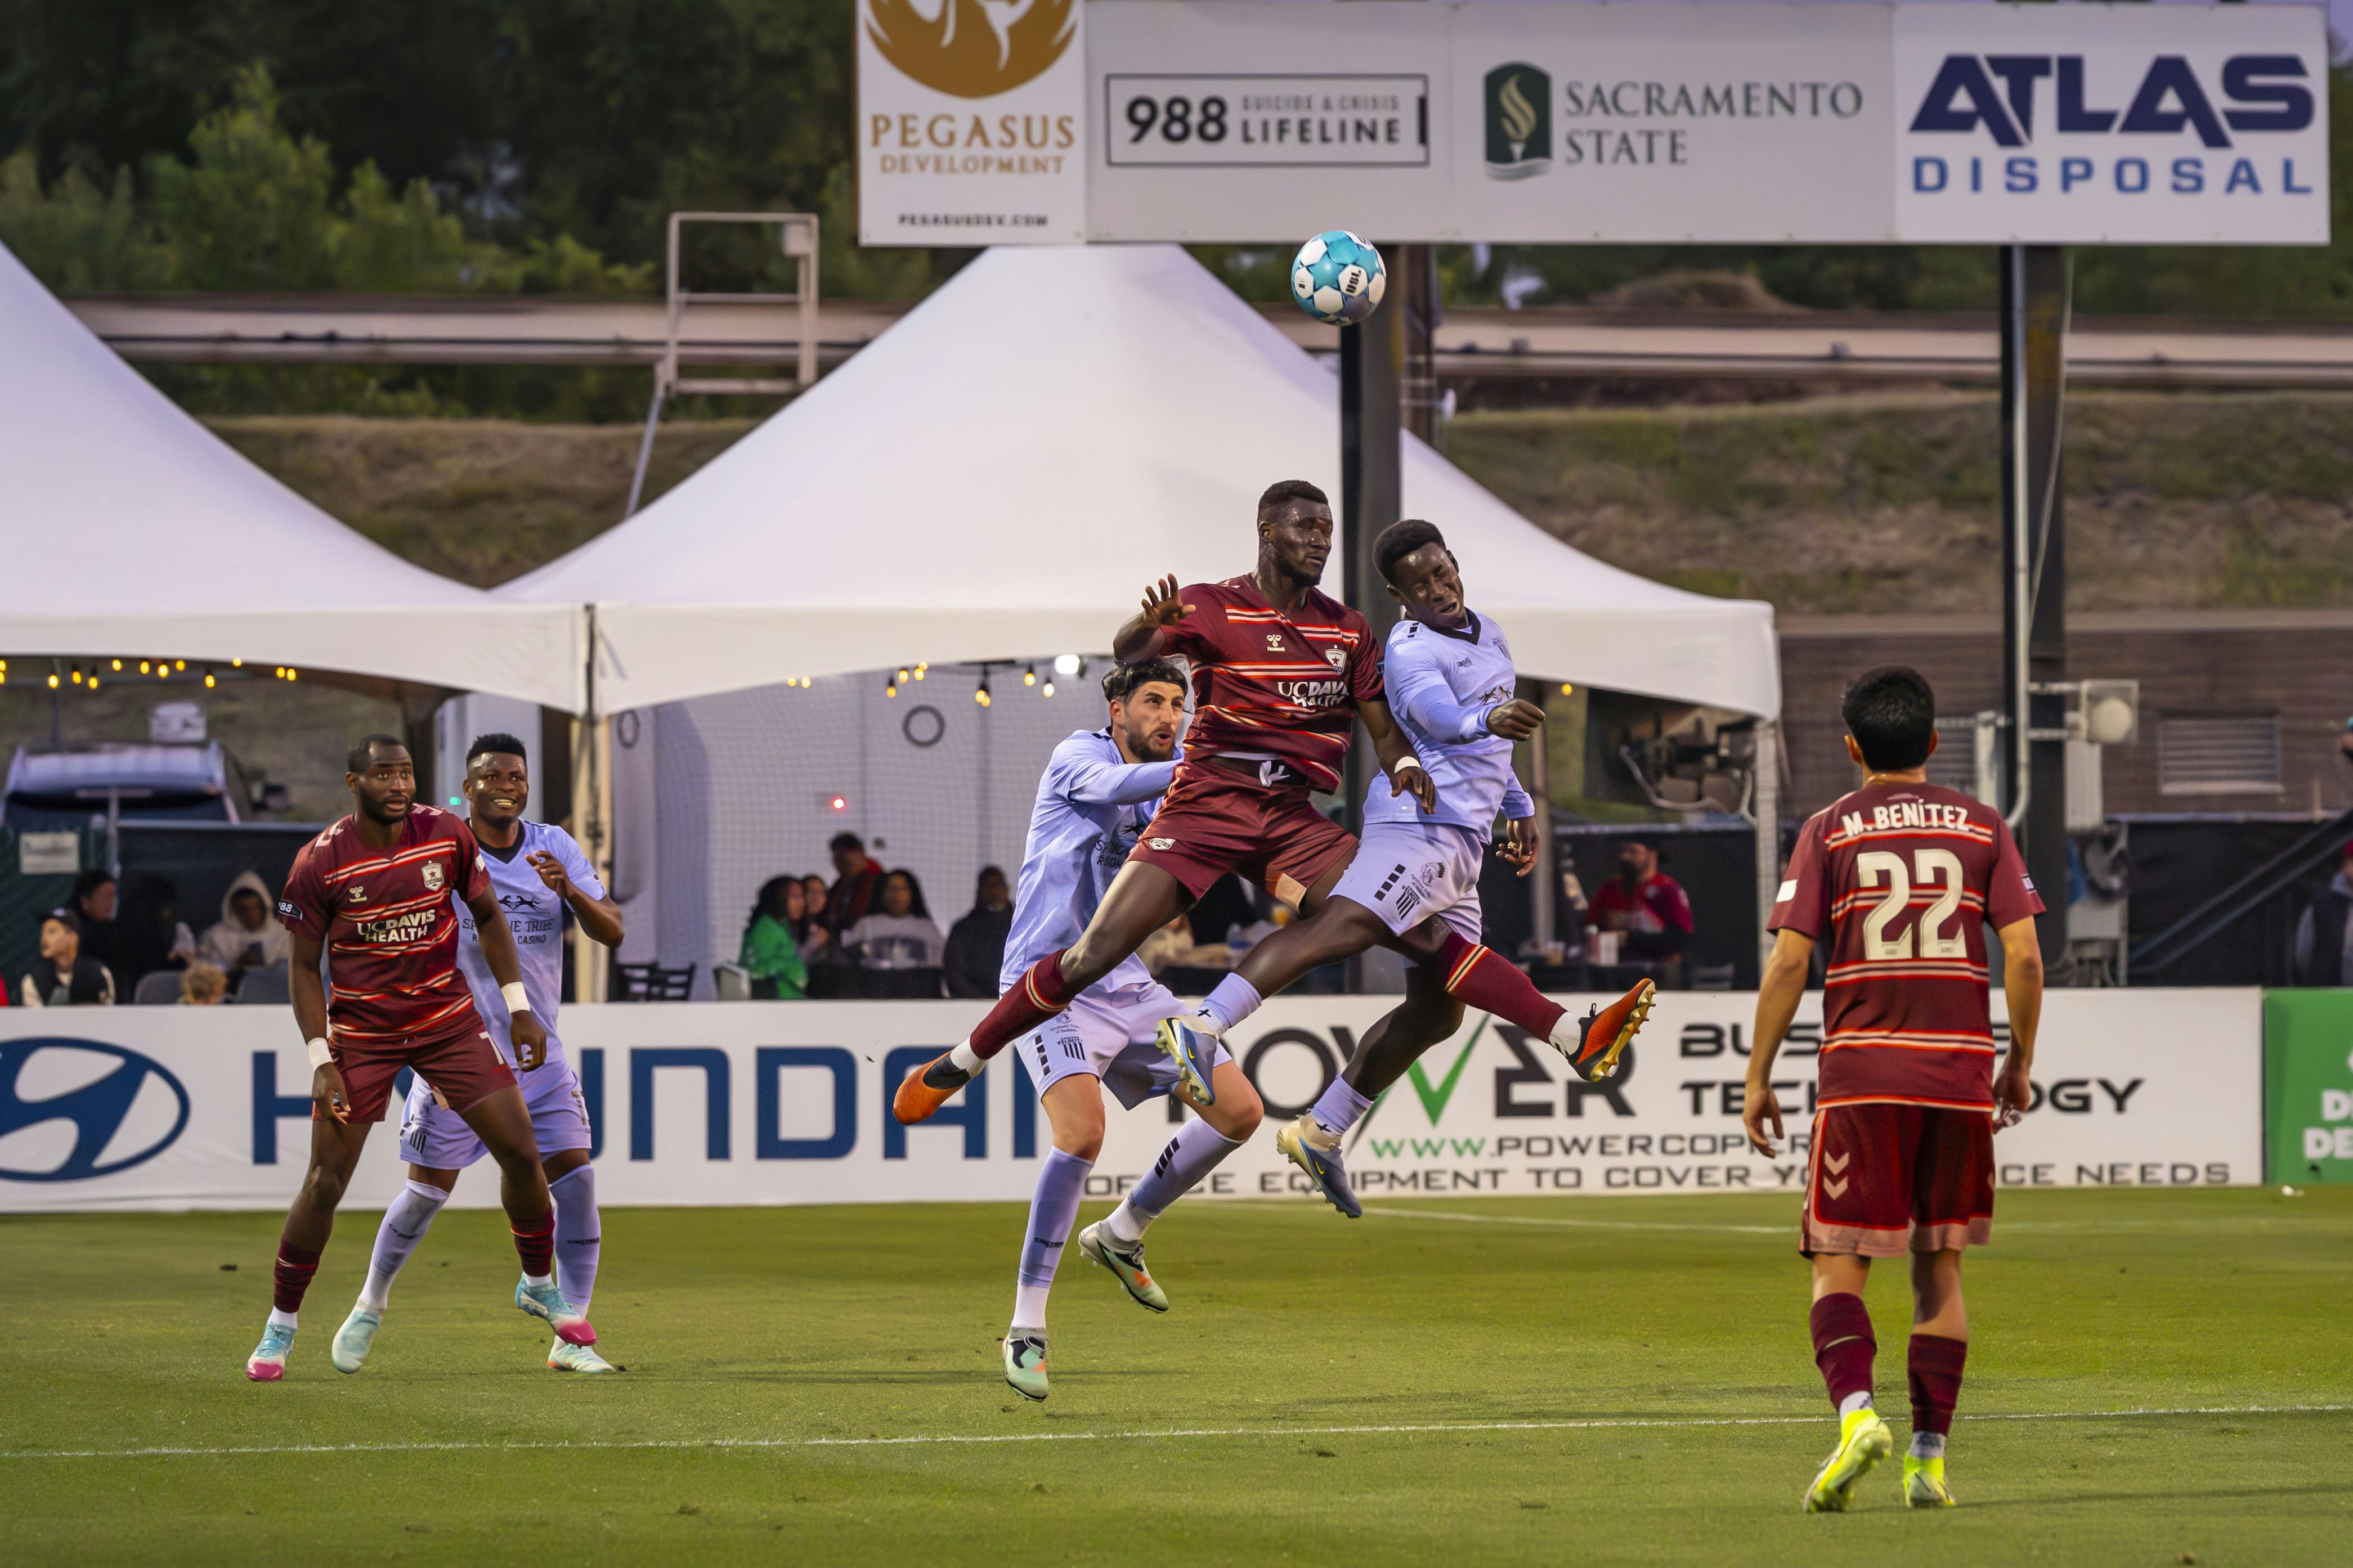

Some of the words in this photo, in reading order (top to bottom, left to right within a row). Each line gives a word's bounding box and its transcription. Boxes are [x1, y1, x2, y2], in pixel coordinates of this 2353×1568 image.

[1565, 81, 1863, 118] SACRAMENTO
[1908, 55, 2316, 149] ATLAS
[870, 114, 1074, 149] PEGASUS
[1126, 96, 1228, 144] 988
[1242, 95, 1313, 111] SUICIDE
[1338, 95, 1400, 110] CRISIS
[1242, 119, 1400, 144] LIFELINE
[1565, 129, 1688, 165] STATE
[880, 155, 1066, 175] DEVELOPMENT
[1913, 156, 2313, 195] DISPOSAL
[1857, 848, 1967, 961] 22
[365, 925, 428, 942] HEALTH
[517, 934, 546, 945] CASINO
[526, 919, 554, 932] TRIBE
[1168, 1014, 1636, 1148] OWER
[1260, 1169, 1509, 1193] EQIPMENT
[1526, 1167, 1583, 1188] TO
[1604, 1166, 1750, 1188] COVER
[2077, 1162, 2230, 1185] NEEDS
